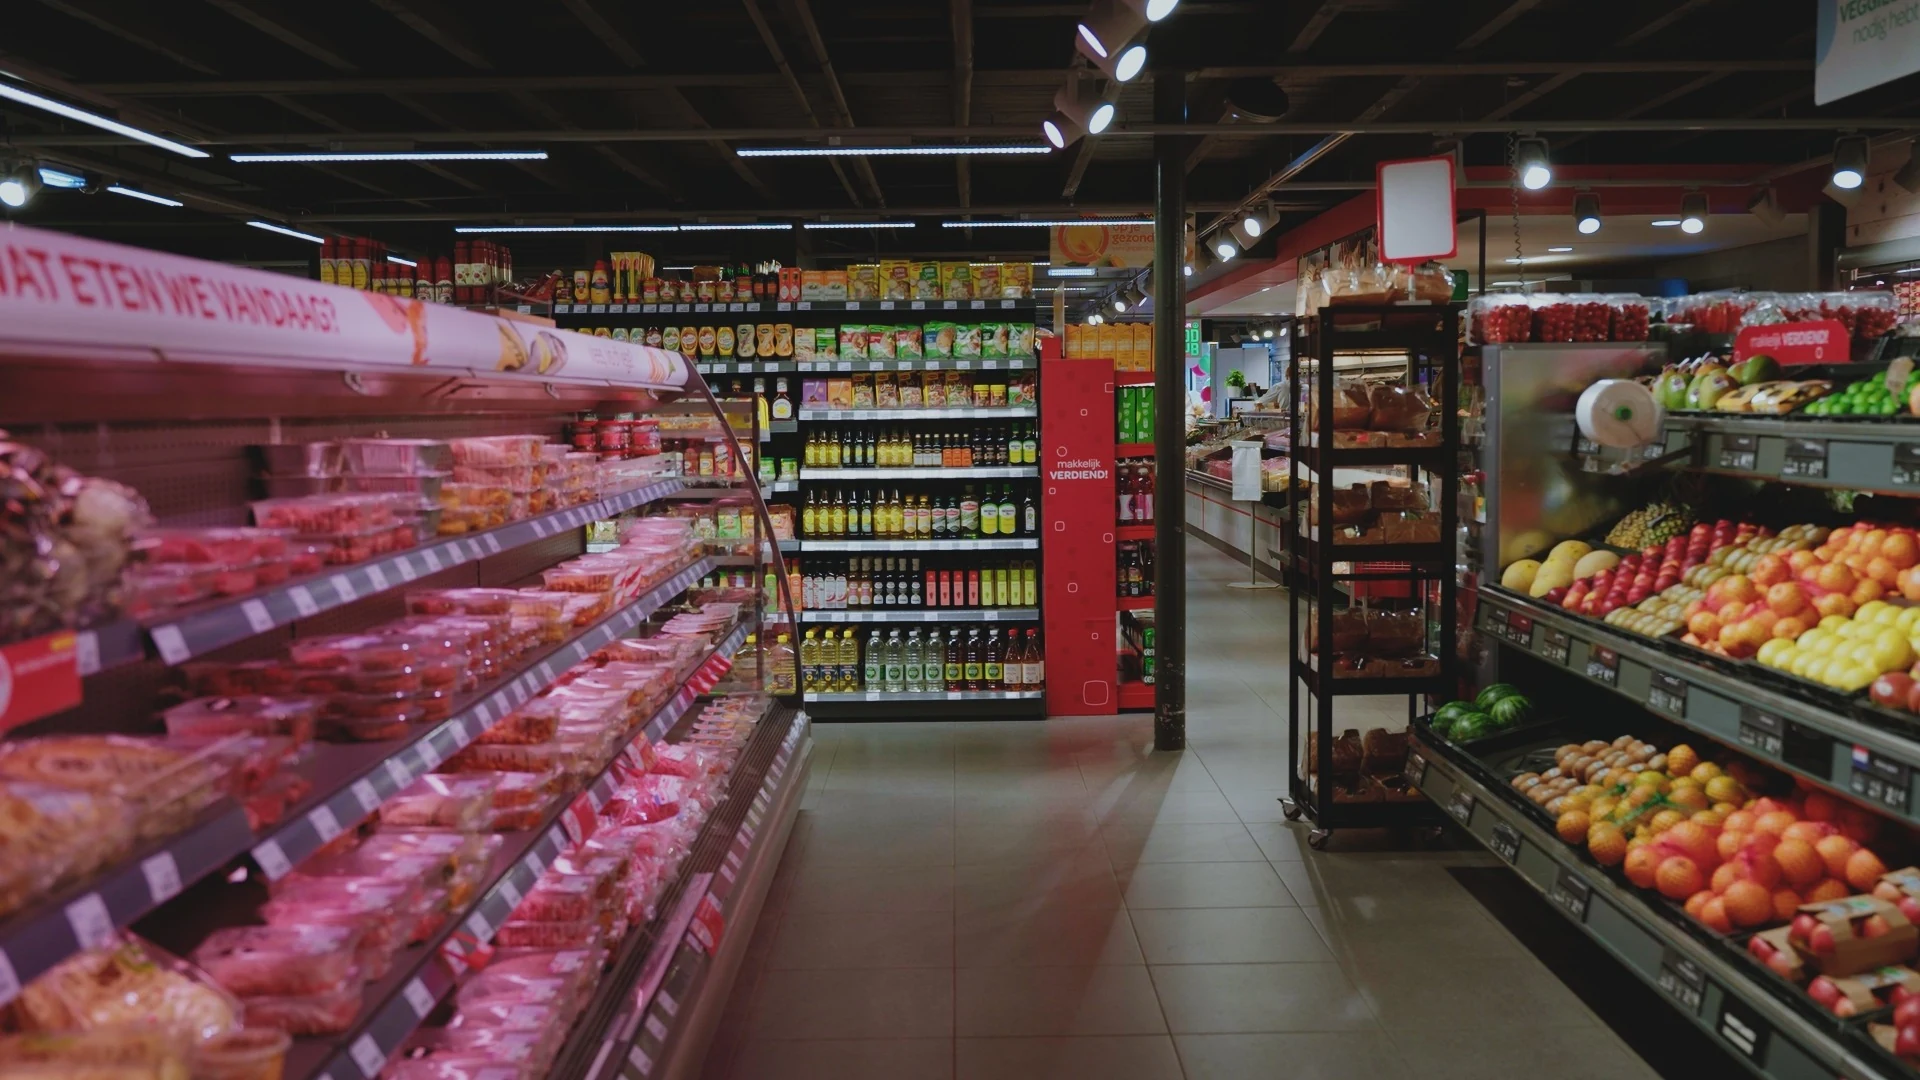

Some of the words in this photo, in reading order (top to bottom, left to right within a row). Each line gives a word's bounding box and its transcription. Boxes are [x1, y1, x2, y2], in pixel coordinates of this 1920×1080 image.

[60, 253, 165, 315] ETEN
[162, 268, 215, 320] WE
[214, 279, 340, 334] VANDAAG?
[1057, 459, 1101, 470] makkelijk
[1050, 470, 1109, 480] VERDIEND!
